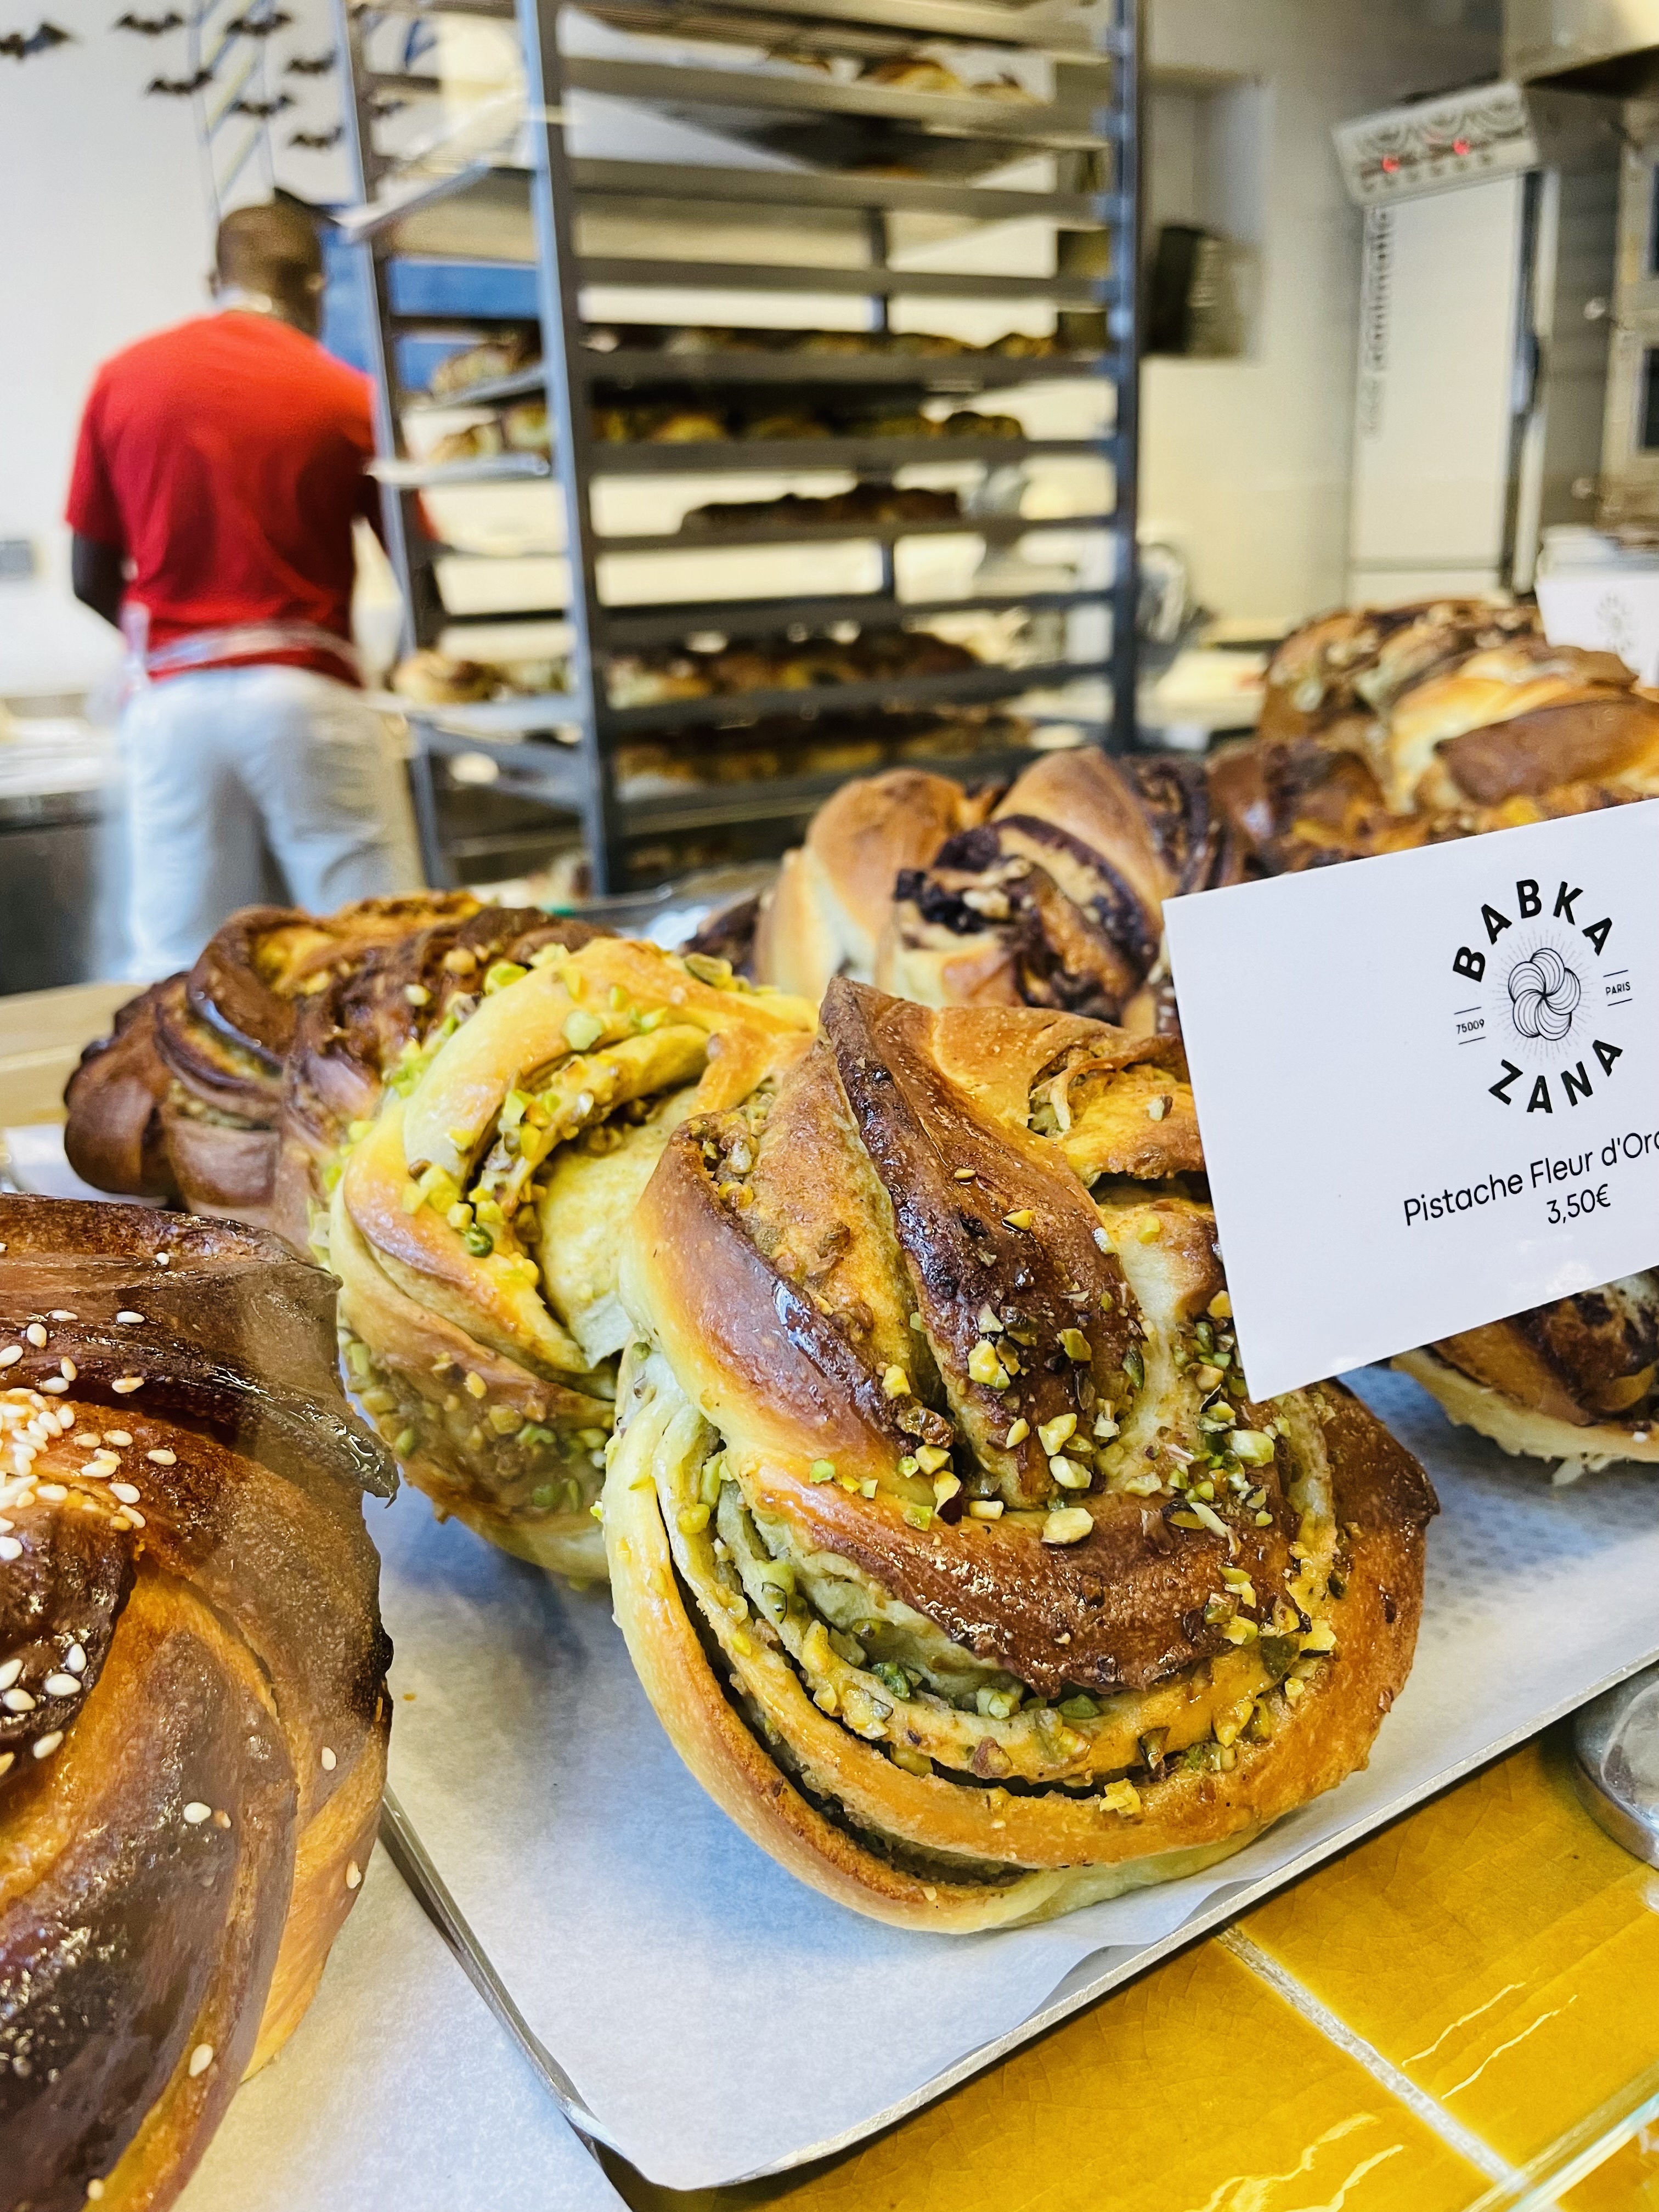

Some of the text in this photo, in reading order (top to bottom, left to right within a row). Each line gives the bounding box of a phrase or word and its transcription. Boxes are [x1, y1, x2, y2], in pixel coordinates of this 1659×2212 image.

[1452, 879, 1612, 983] BABKA
[1605, 981, 1631, 996] PARIS
[1455, 1019, 1485, 1035] 75009
[1488, 1040, 1623, 1114] ZANA
[1404, 1174, 1523, 1226] Pistache
[1530, 1152, 1593, 1188] Fleur
[1547, 1183, 1611, 1224] 3,50€
